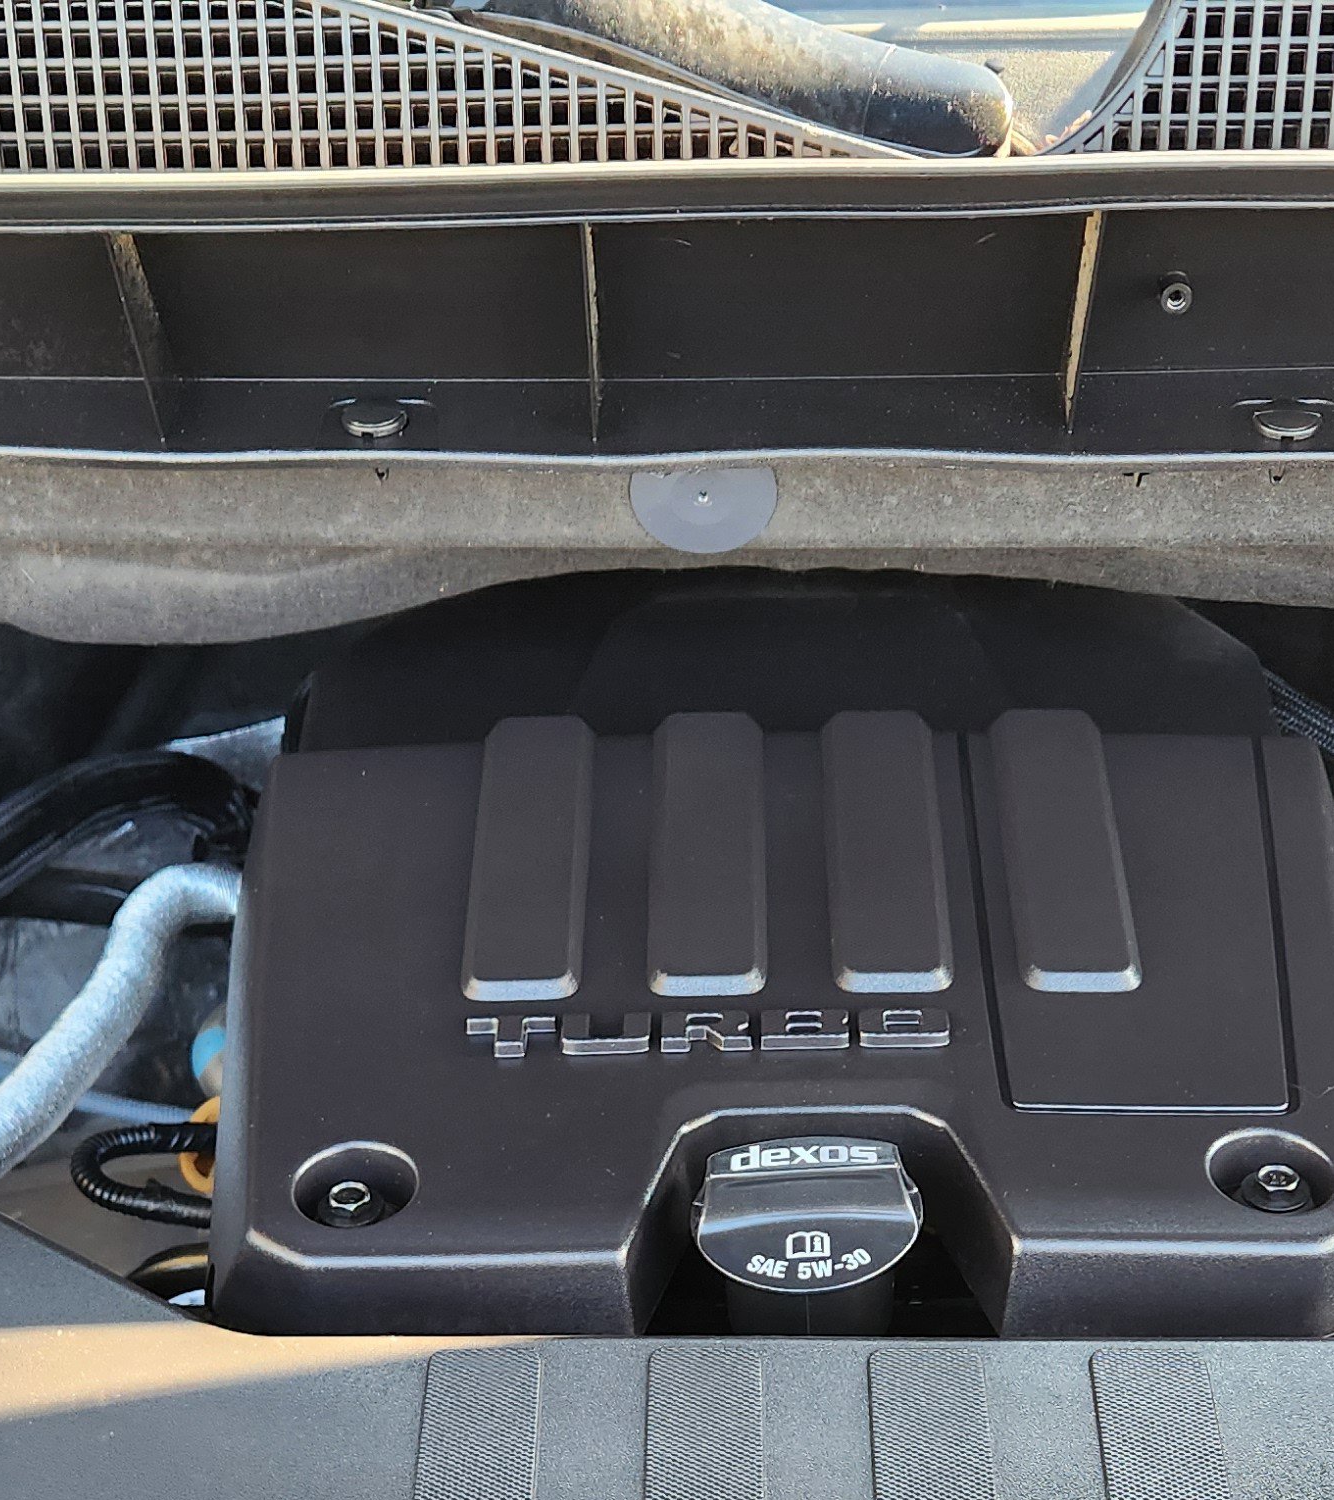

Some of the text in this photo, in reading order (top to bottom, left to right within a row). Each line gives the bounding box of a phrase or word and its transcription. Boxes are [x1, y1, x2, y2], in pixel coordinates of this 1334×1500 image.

[466, 1008, 951, 1058] TURBO
[730, 1144, 879, 1172] dexos
[746, 1248, 872, 1280] SAE 5W-30
